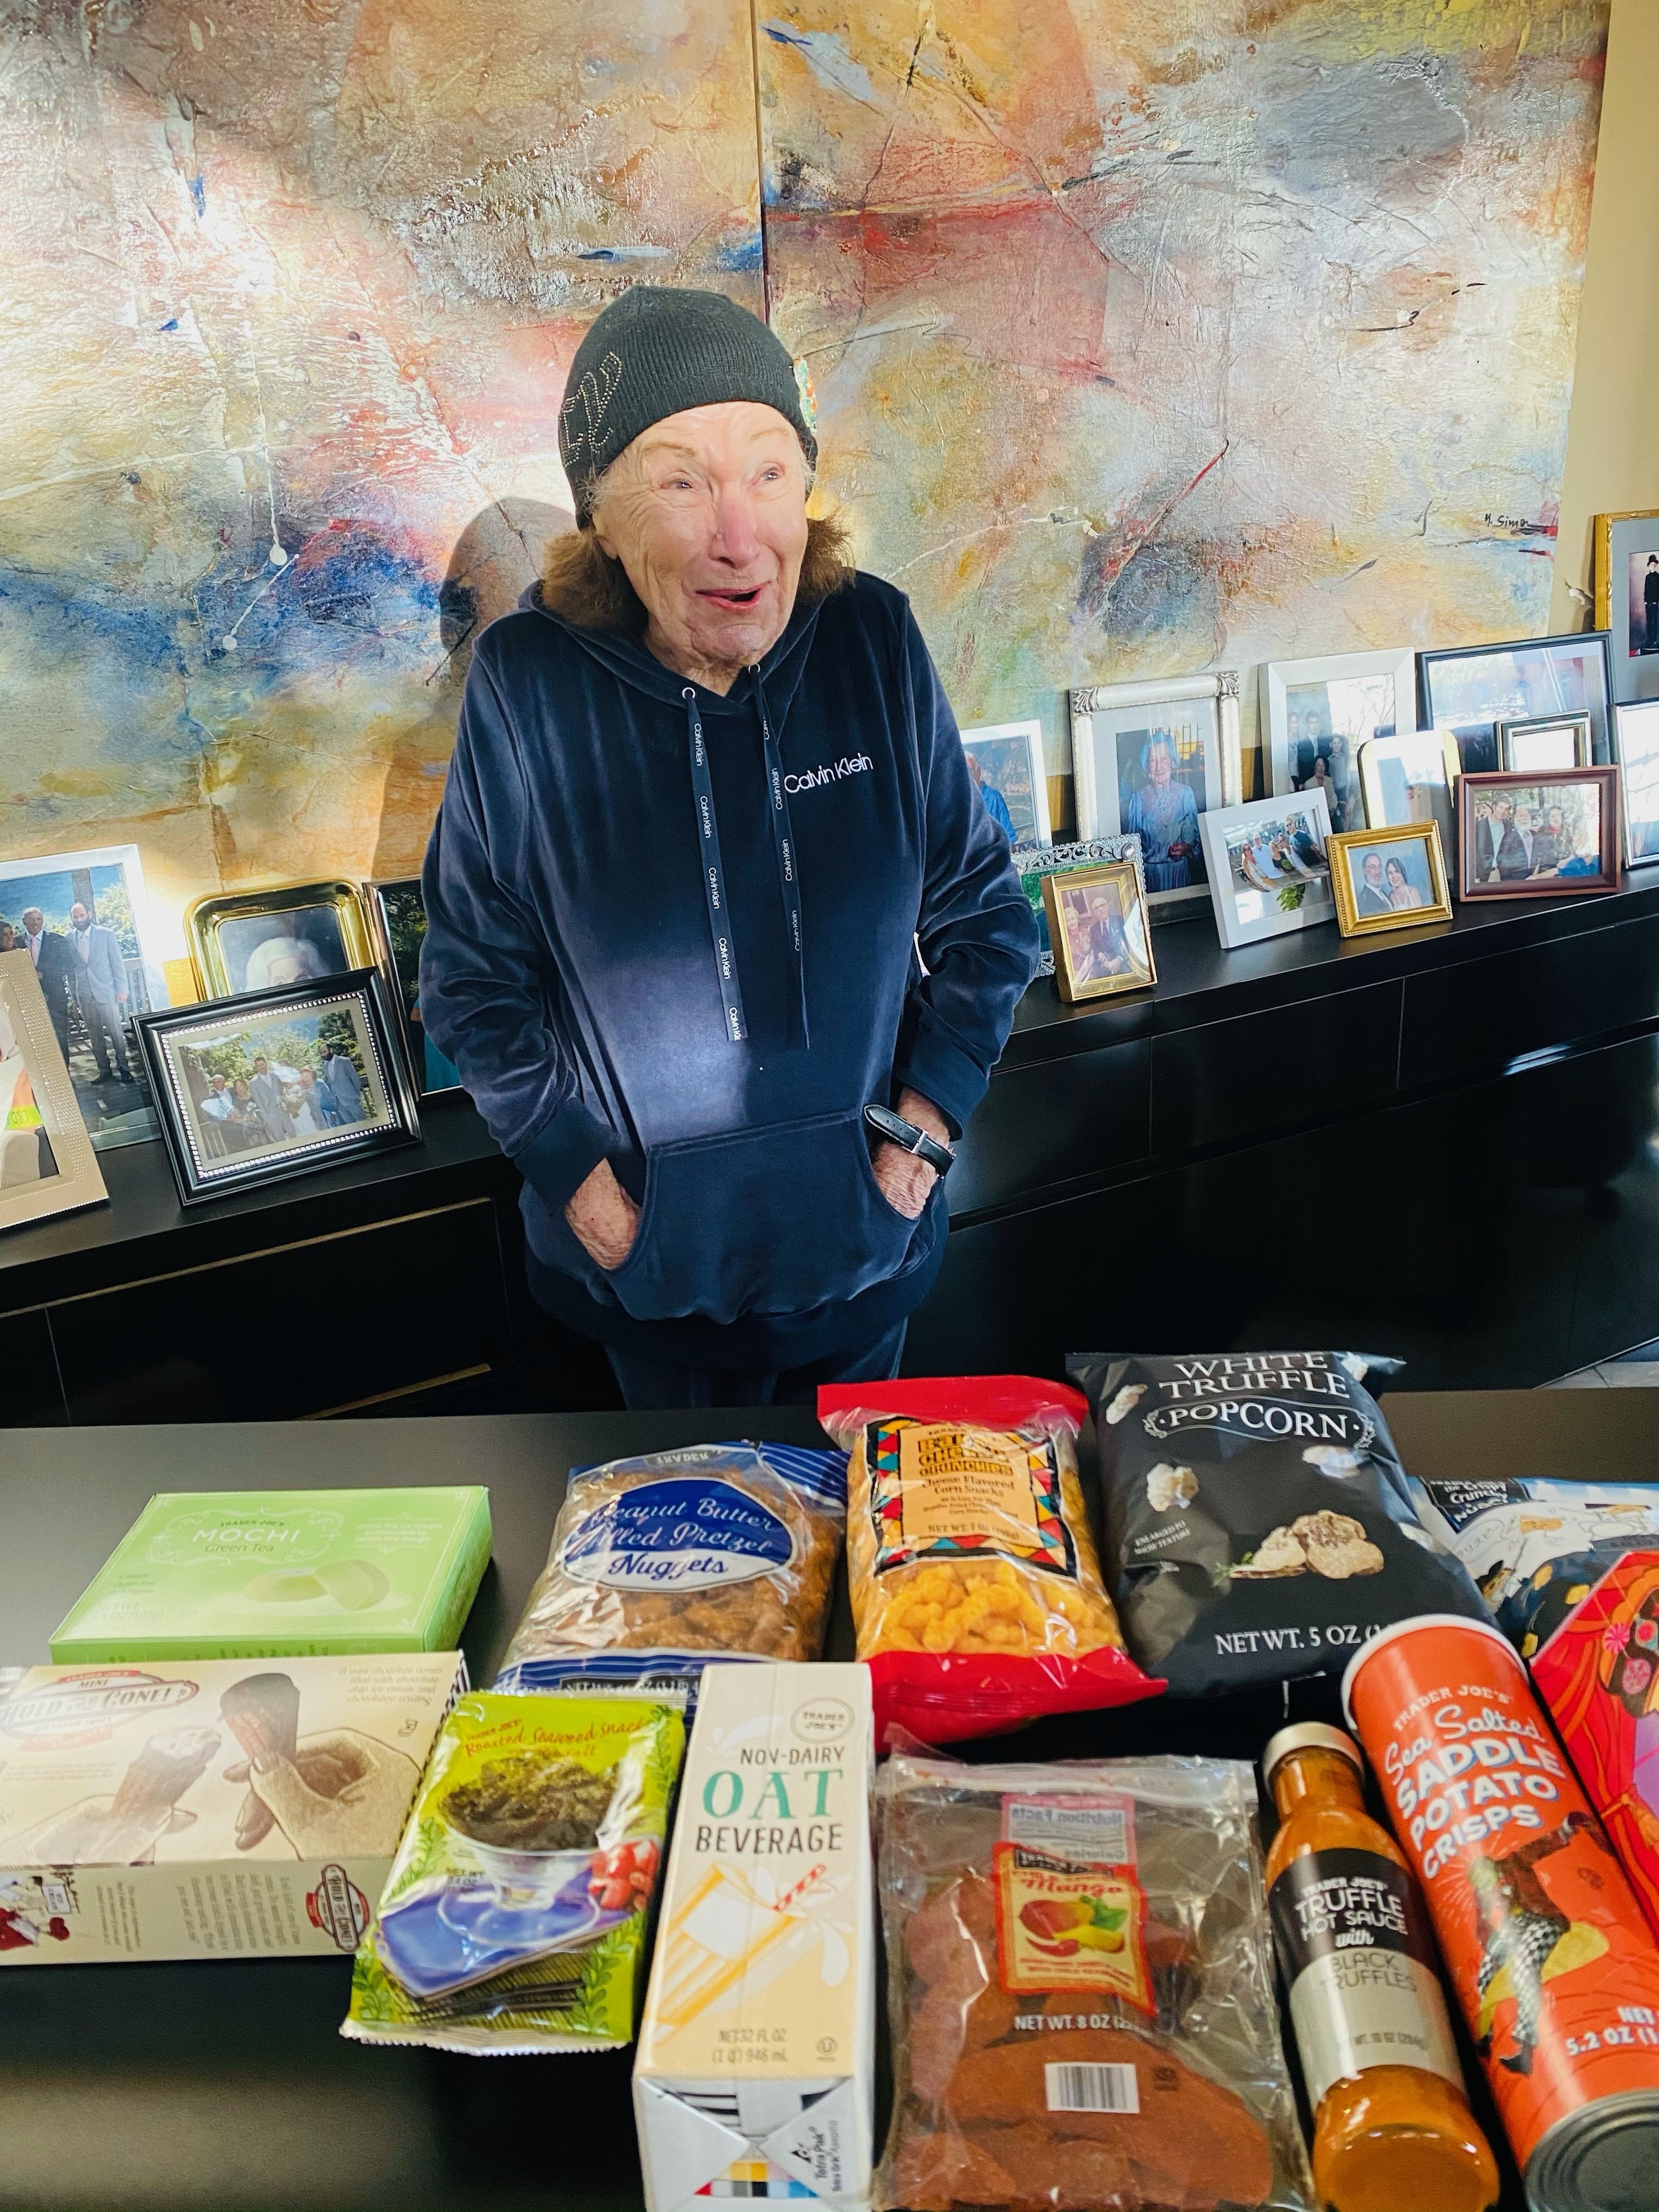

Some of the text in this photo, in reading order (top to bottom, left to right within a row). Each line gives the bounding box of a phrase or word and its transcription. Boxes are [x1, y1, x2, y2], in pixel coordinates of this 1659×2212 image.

[784, 752, 874, 793] Calvin Klein
[771, 768, 783, 810] Calvin Klein
[700, 796, 712, 838] Calvin Klein
[781, 838, 793, 881] Calvin Klein
[708, 867, 721, 909] Calvin Klein
[719, 937, 731, 979] Calvin Klein
[729, 1006, 739, 1031] Calvin
[1174, 1350, 1328, 1379] WHITE
[1159, 1369, 1350, 1399] TRUFFLE
[1168, 1400, 1348, 1439] POPCORN
[935, 1485, 962, 1495] Corn
[964, 1475, 1015, 1490] Flavored
[696, 1497, 775, 1532] Butter
[928, 1524, 948, 1533] NET
[192, 1528, 300, 1542] MOCHI
[205, 1544, 247, 1552] Green
[669, 1521, 774, 1552] Pretzel
[608, 1553, 729, 1580] Nuggets
[1214, 1625, 1361, 1655] NET WT. 5 OZ
[79, 1678, 109, 1688] MINI
[101, 1688, 171, 1711] CONE!
[1392, 1684, 1510, 1732] TRADER JOE'S
[804, 1712, 845, 1721] TRADER
[465, 1725, 524, 1757] Roasted
[533, 1722, 595, 1745] Seaweed
[1385, 1704, 1546, 1786] Sea Salted
[1397, 1736, 1567, 1820] SADDLE
[702, 1768, 844, 1820] OAT
[1410, 1771, 1559, 1852] POTATO
[695, 1823, 843, 1854] BEVERAGE
[1423, 1804, 1543, 1879] CRISPS
[1021, 1874, 1123, 1897] Mango
[1302, 1876, 1389, 1897] TRADER JOE'S
[1295, 1887, 1406, 1924] TRUFFLE
[1300, 1910, 1409, 1942] HOT SAUCE
[1335, 1928, 1375, 1948] with
[1331, 1952, 1400, 1973] BLACK
[1330, 1970, 1417, 1992] RUFFLES
[1014, 2013, 1044, 2031] NET
[1077, 2014, 1088, 2030] 8
[1089, 2013, 1112, 2029] OZ
[1616, 2006, 1656, 2026] NET
[1566, 2031, 1601, 2057] 5.2
[1604, 2026, 1635, 2046] OZ
[815, 2154, 828, 2180] Tetra
